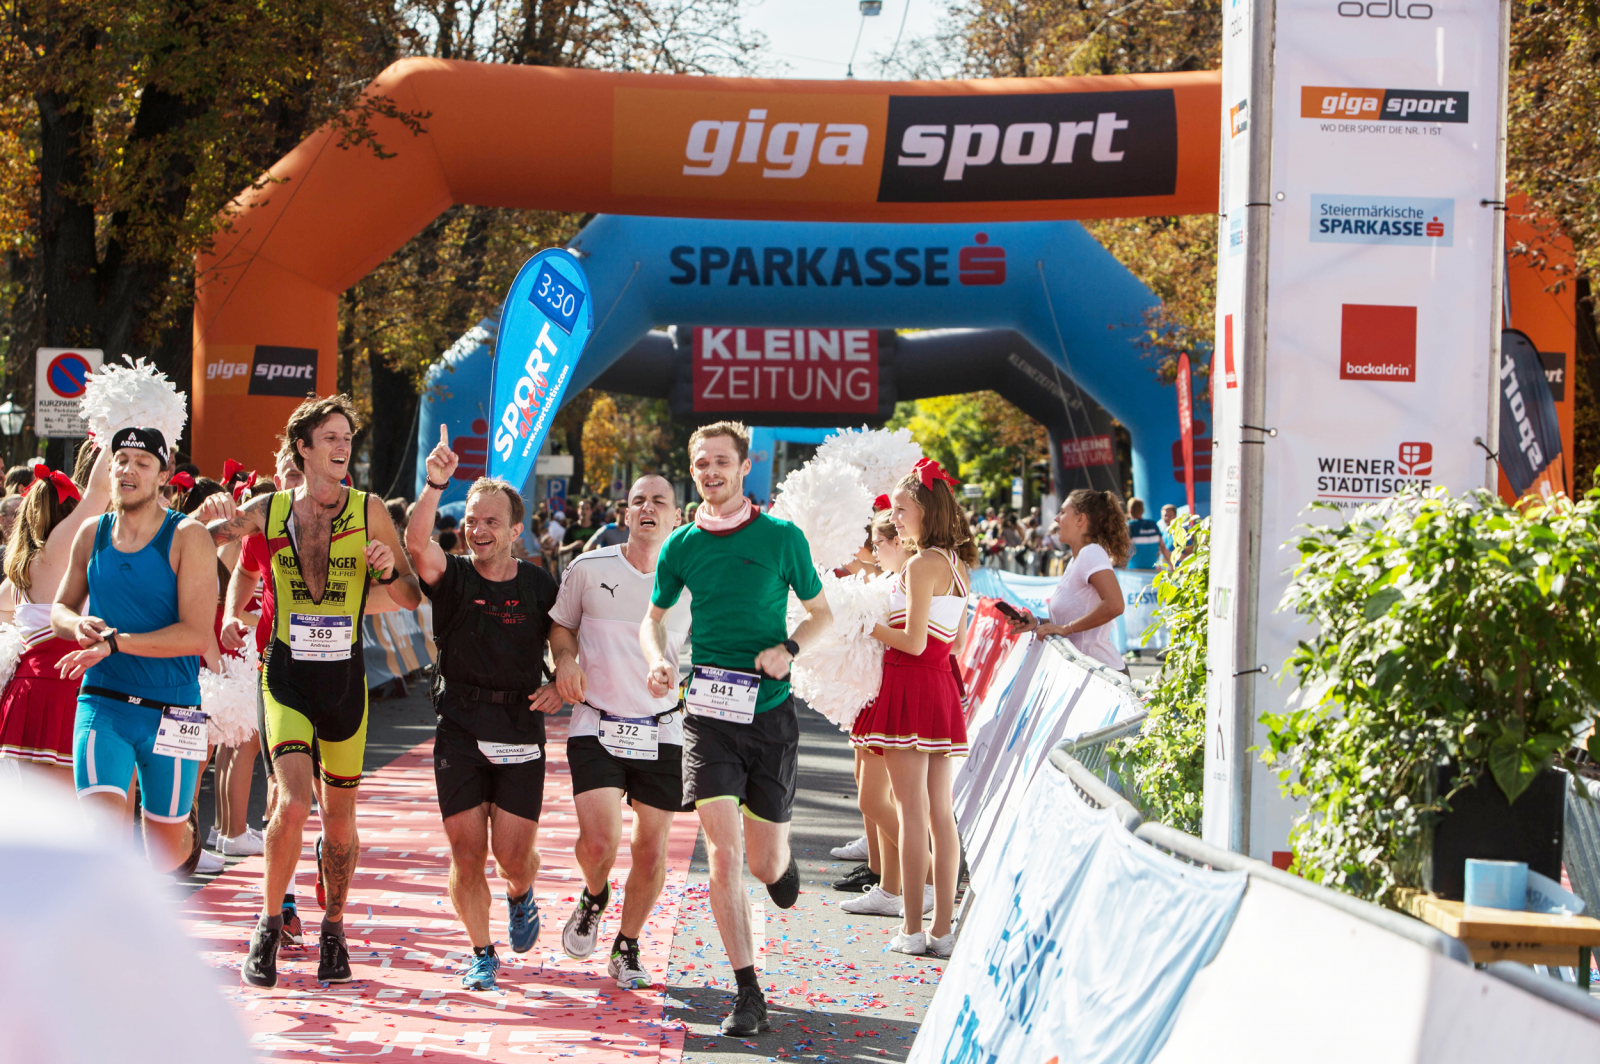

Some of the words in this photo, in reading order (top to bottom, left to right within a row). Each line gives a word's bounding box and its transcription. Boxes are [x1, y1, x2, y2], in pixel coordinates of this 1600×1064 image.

[1321, 92, 1379, 115] giga
[1386, 97, 1457, 117] sport
[1320, 123, 1337, 132] WO
[1338, 124, 1356, 133] DER
[1358, 124, 1386, 134] SPORT
[1389, 126, 1403, 135] DIE
[1405, 126, 1420, 135] NR.
[1423, 126, 1427, 135] 1
[1429, 127, 1442, 136] IST
[683, 109, 869, 178] giga
[898, 112, 1129, 181] sport
[1320, 203, 1424, 219] Steiermärkische
[1319, 218, 1424, 237] SPARKASSE
[669, 245, 950, 287] SPARKASSE
[538, 273, 575, 317] 3:30
[702, 328, 871, 362] KLEINE
[206, 359, 248, 380] giga
[254, 363, 314, 381] sport
[1346, 362, 1410, 377] backaldrin
[494, 321, 558, 463] SPORT
[702, 366, 871, 401] ZEITUNG
[521, 364, 570, 458] www.sportaktiv.com
[120, 440, 146, 448] ARAYA
[1062, 438, 1110, 453] KLEINE
[1317, 457, 1395, 475] WIENER
[278, 554, 357, 570] ERDNGER
[309, 628, 333, 639] 369
[710, 683, 734, 697] 841
[179, 723, 201, 736] 840
[616, 724, 639, 737] 372
